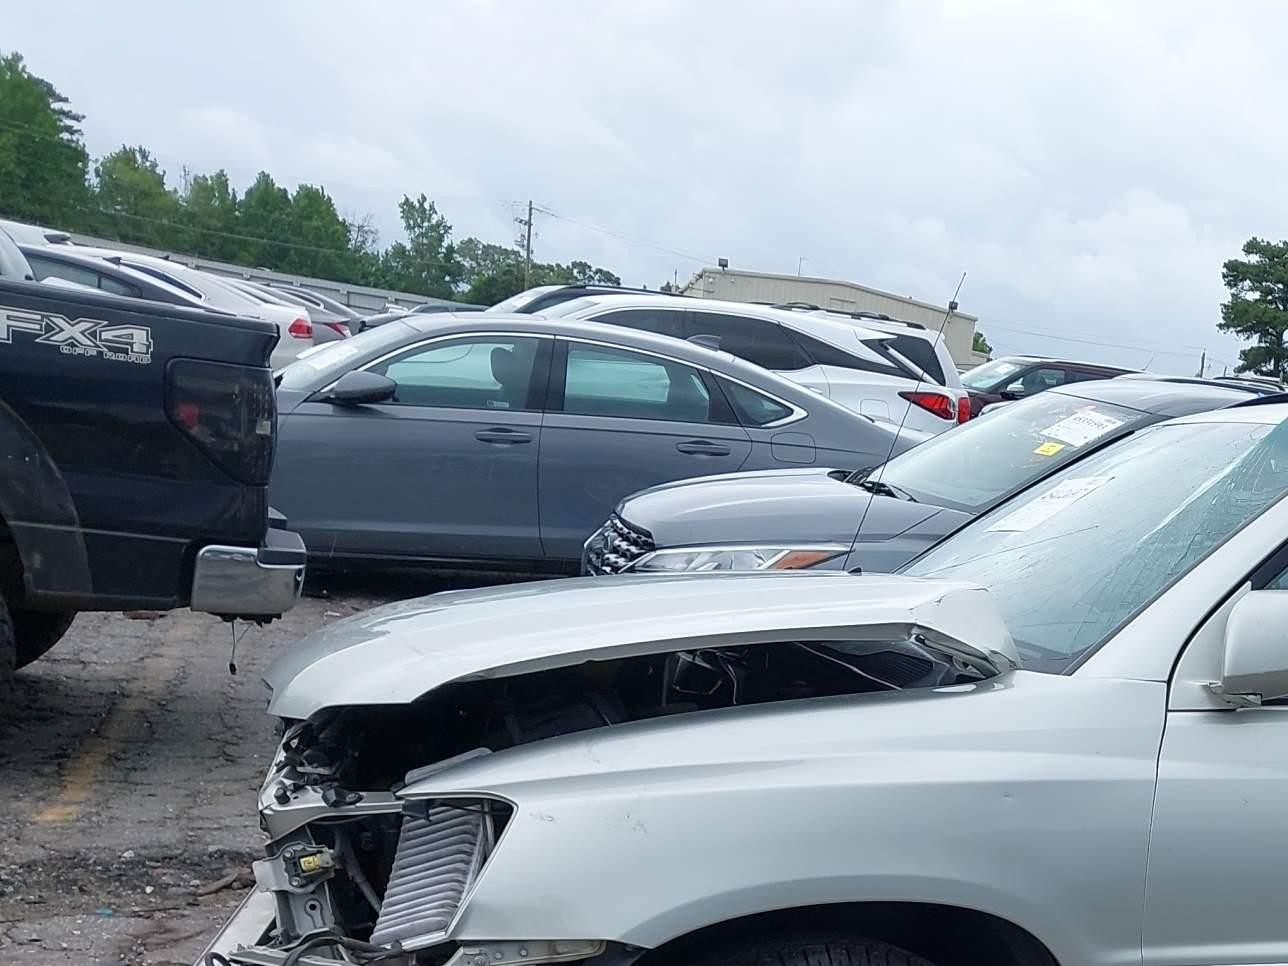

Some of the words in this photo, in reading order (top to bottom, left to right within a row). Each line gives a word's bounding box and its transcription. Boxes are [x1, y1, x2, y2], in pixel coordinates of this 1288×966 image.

[0, 305, 153, 356] FX4
[59, 345, 97, 356] OFF
[103, 351, 151, 364] ROAD
